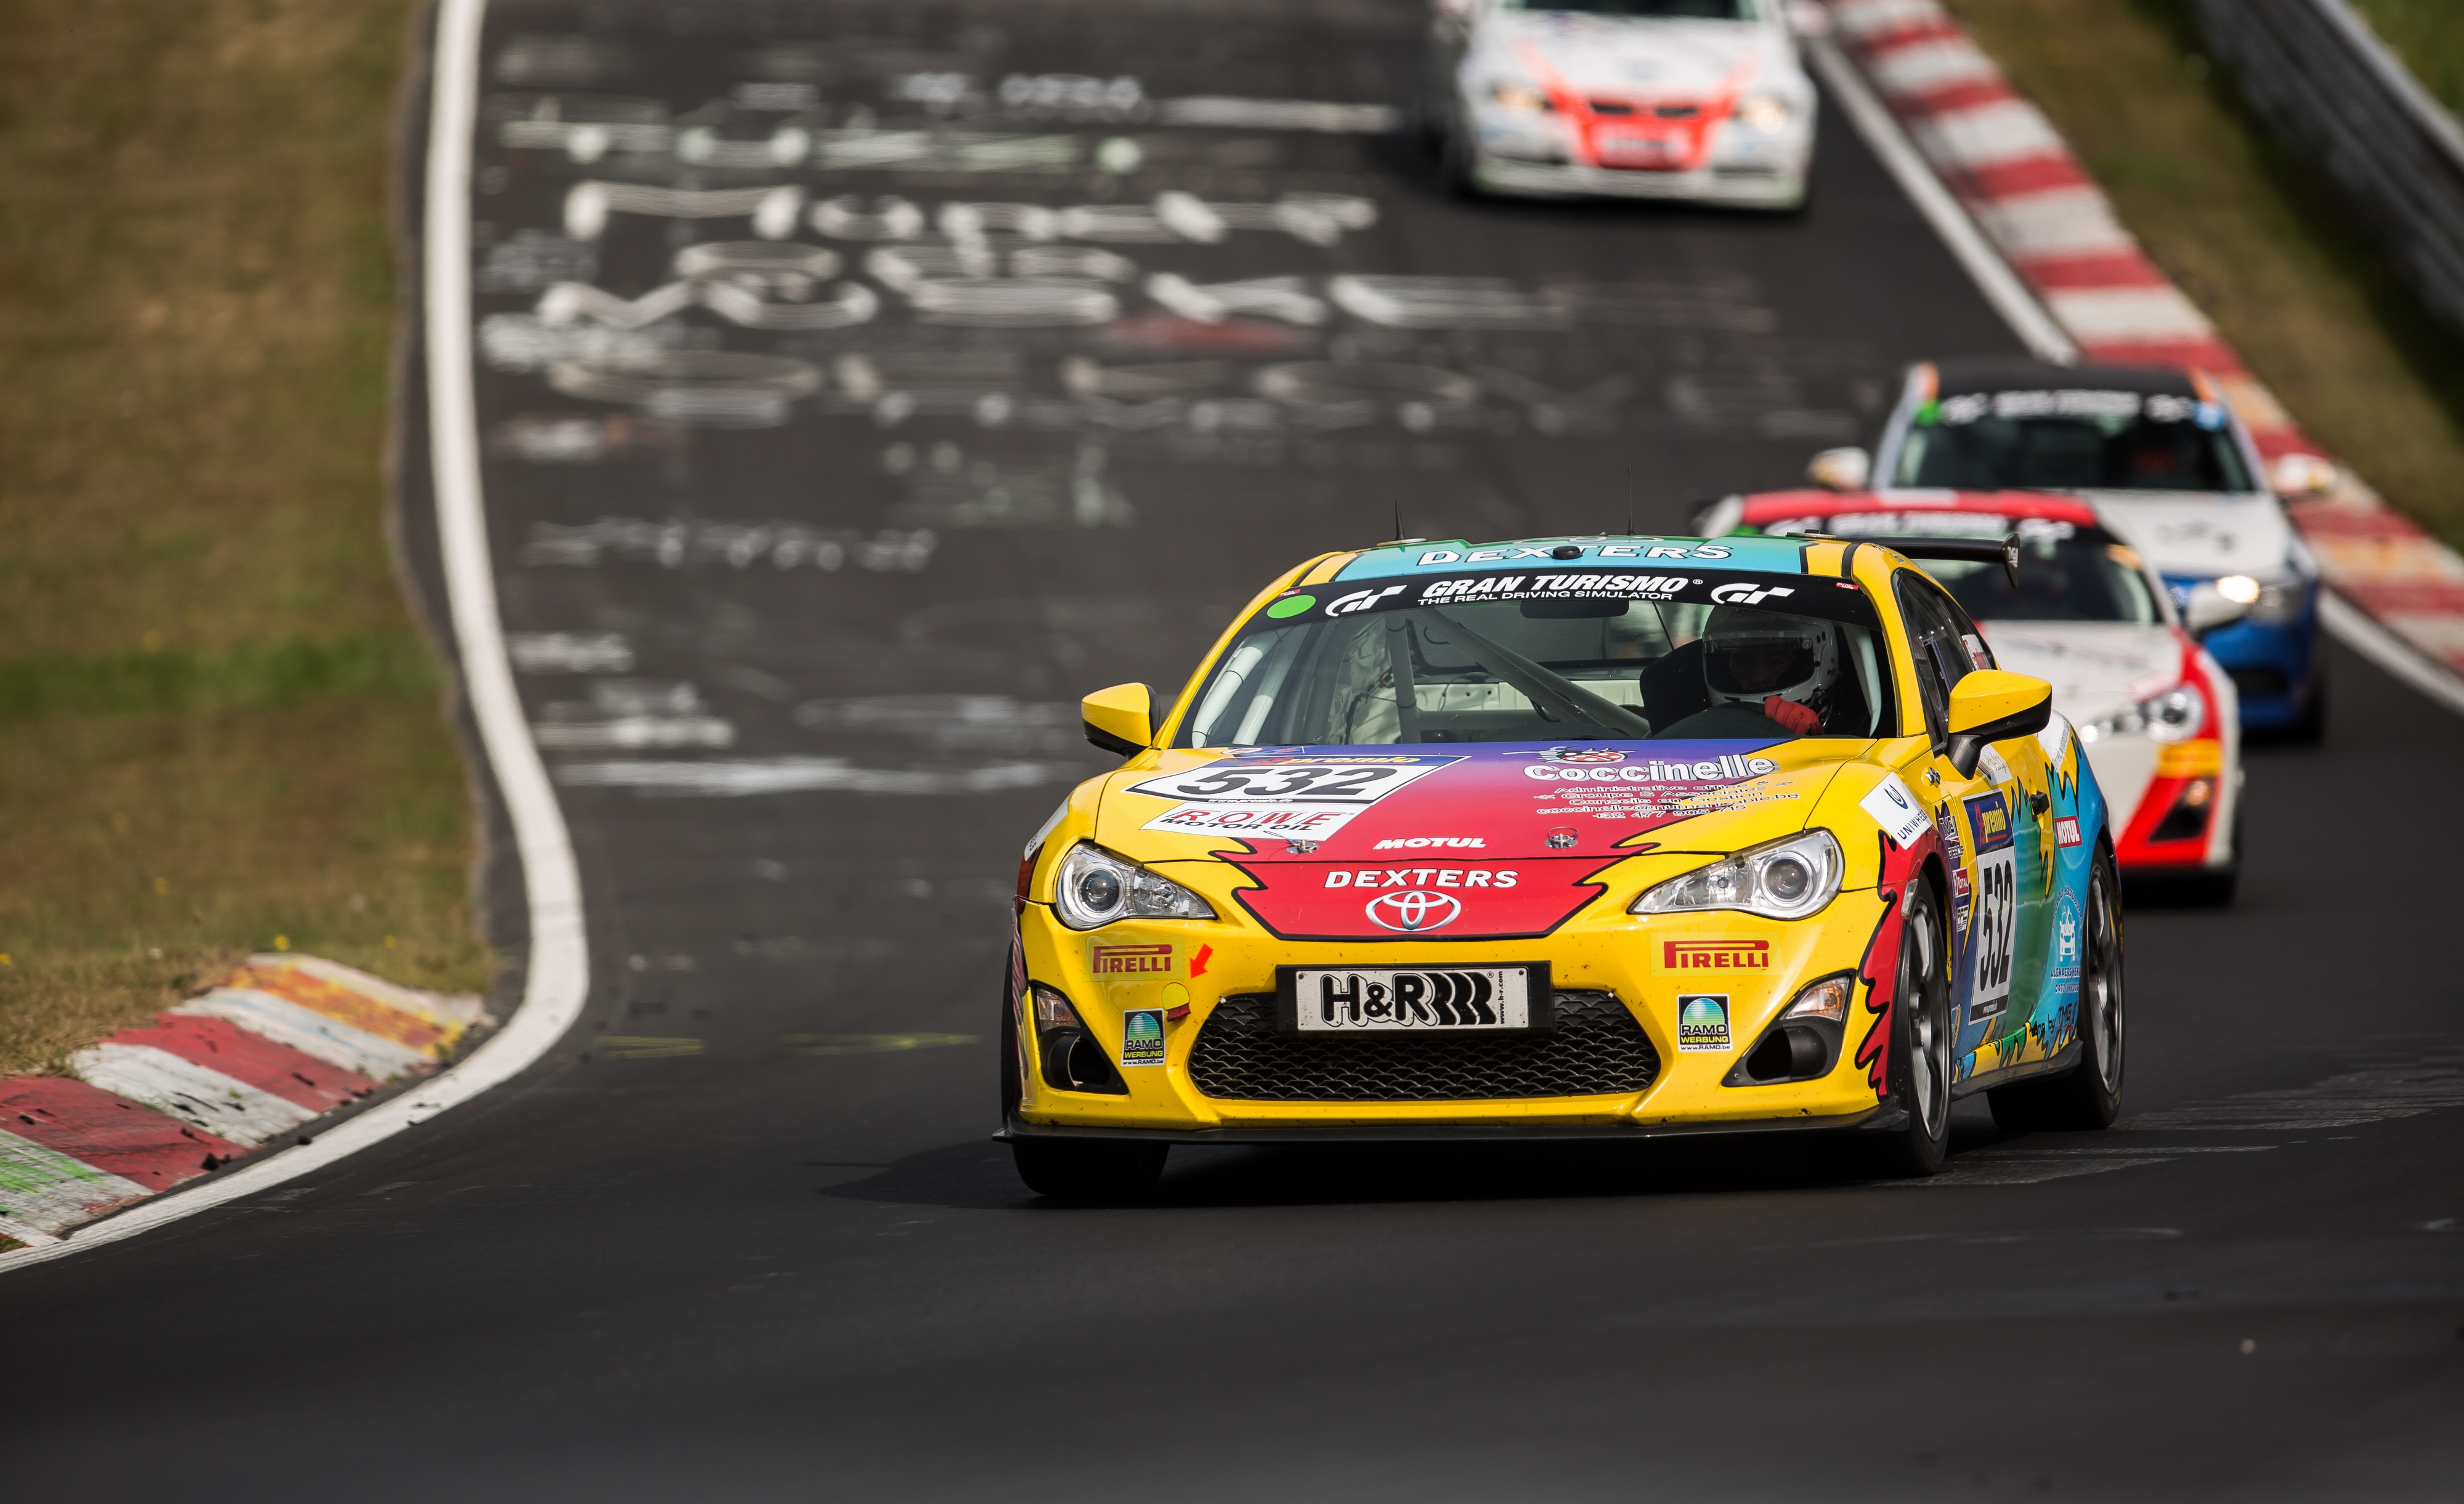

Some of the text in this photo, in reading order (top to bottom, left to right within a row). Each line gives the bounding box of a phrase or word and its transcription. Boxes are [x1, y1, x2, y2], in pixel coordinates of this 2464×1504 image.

[1416, 545, 1733, 566] DEXTERS
[1422, 575, 1689, 597] GRAN TURISMO
[1417, 590, 1673, 606] THE REAL DRIVING SIMULATOR
[1275, 756, 1421, 765] premio
[1523, 754, 1780, 782] Coccinelle
[1177, 767, 1397, 796] 532
[1554, 785, 1687, 794] Administrative
[1569, 798, 1651, 806] Conseils
[1690, 791, 1764, 802] Gestion
[1660, 786, 1767, 797] Associates
[1537, 793, 1800, 814] coccinelle@numericable.be
[1715, 804, 1747, 813] 715
[1159, 818, 1260, 830] MOTOR
[1169, 809, 1342, 826] ROWE
[1982, 801, 2007, 843] premio
[2056, 819, 2080, 845] MOTUL
[1372, 837, 1486, 850] MOTUL
[1324, 868, 1520, 888] DEXTERS
[1957, 876, 1969, 889] TOTAL
[1980, 859, 2013, 992] 532
[1093, 944, 1172, 973] PIRELLI
[1664, 940, 1769, 968] PIRELLI
[1680, 1024, 1728, 1035] RAMO
[1124, 1037, 1164, 1051] RAMO
[1124, 1050, 1164, 1059] WERBUNG
